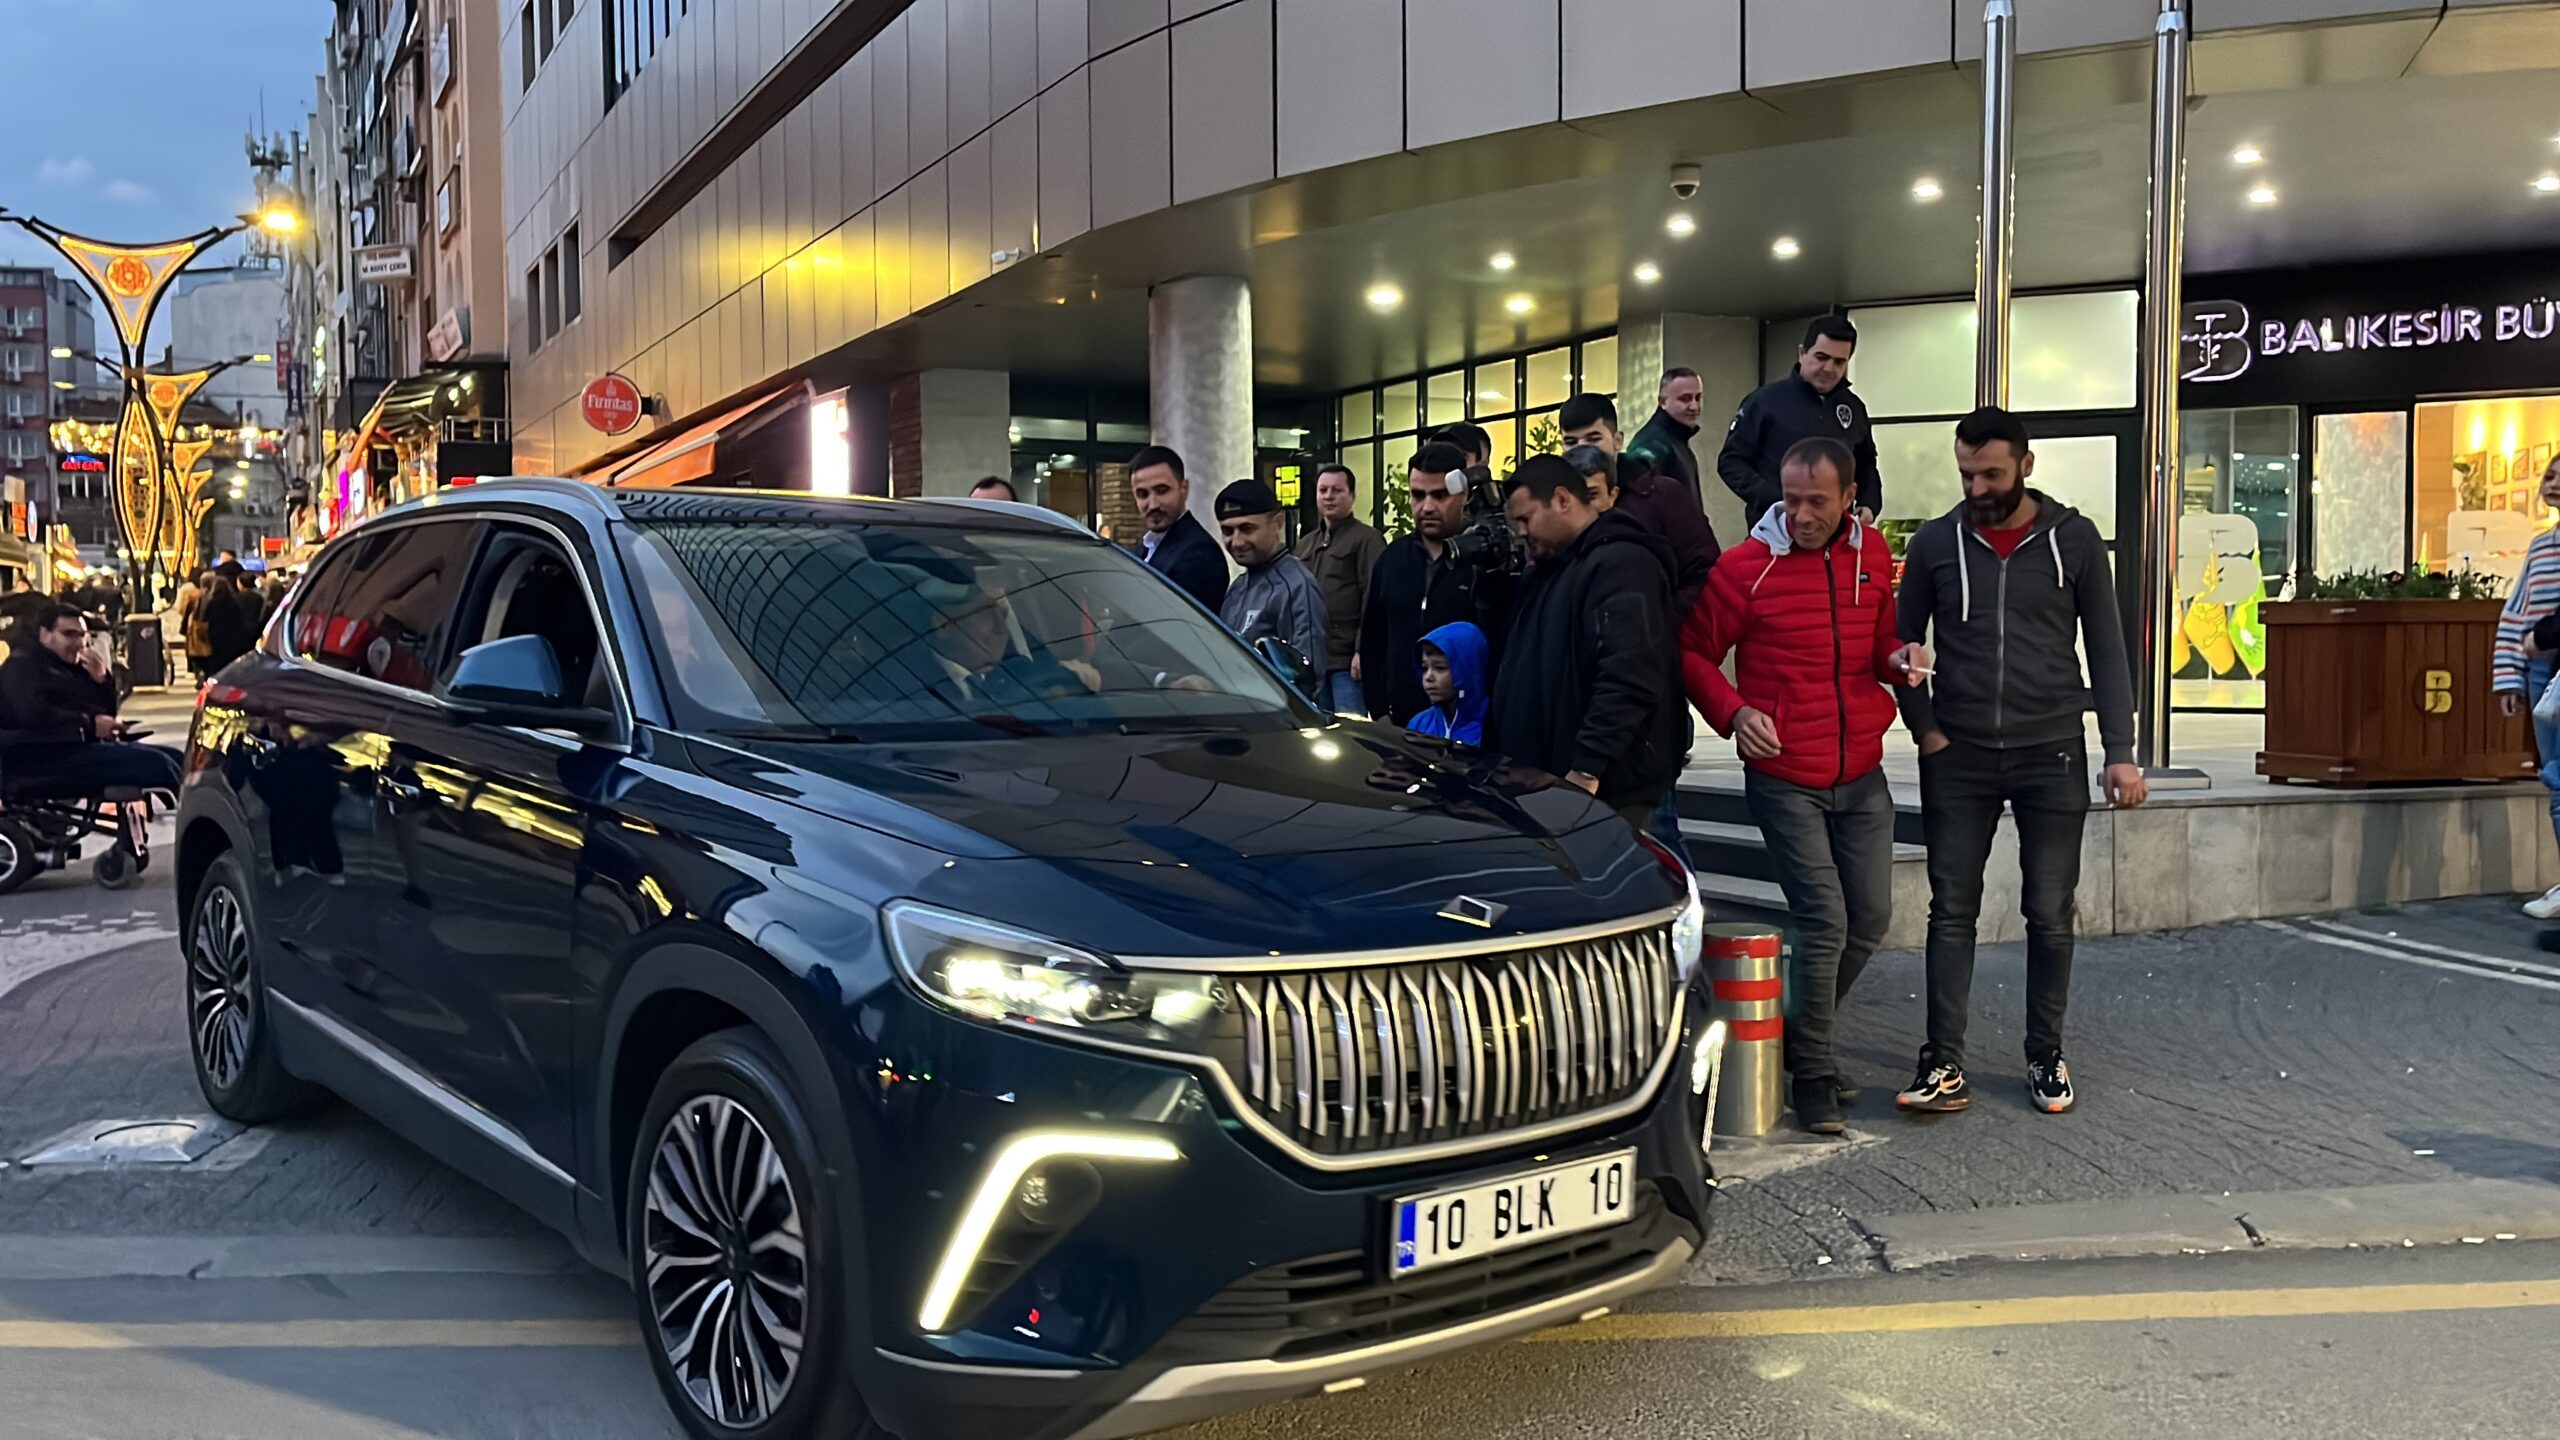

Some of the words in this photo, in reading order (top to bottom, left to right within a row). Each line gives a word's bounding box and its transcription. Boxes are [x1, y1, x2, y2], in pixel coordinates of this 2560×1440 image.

[2260, 303, 2483, 356] BALIKESİR
[2495, 296, 2560, 342] BÜ
[1427, 1198, 1465, 1254] 10
[1494, 1177, 1556, 1239] BLK
[1589, 1162, 1622, 1215] 10
